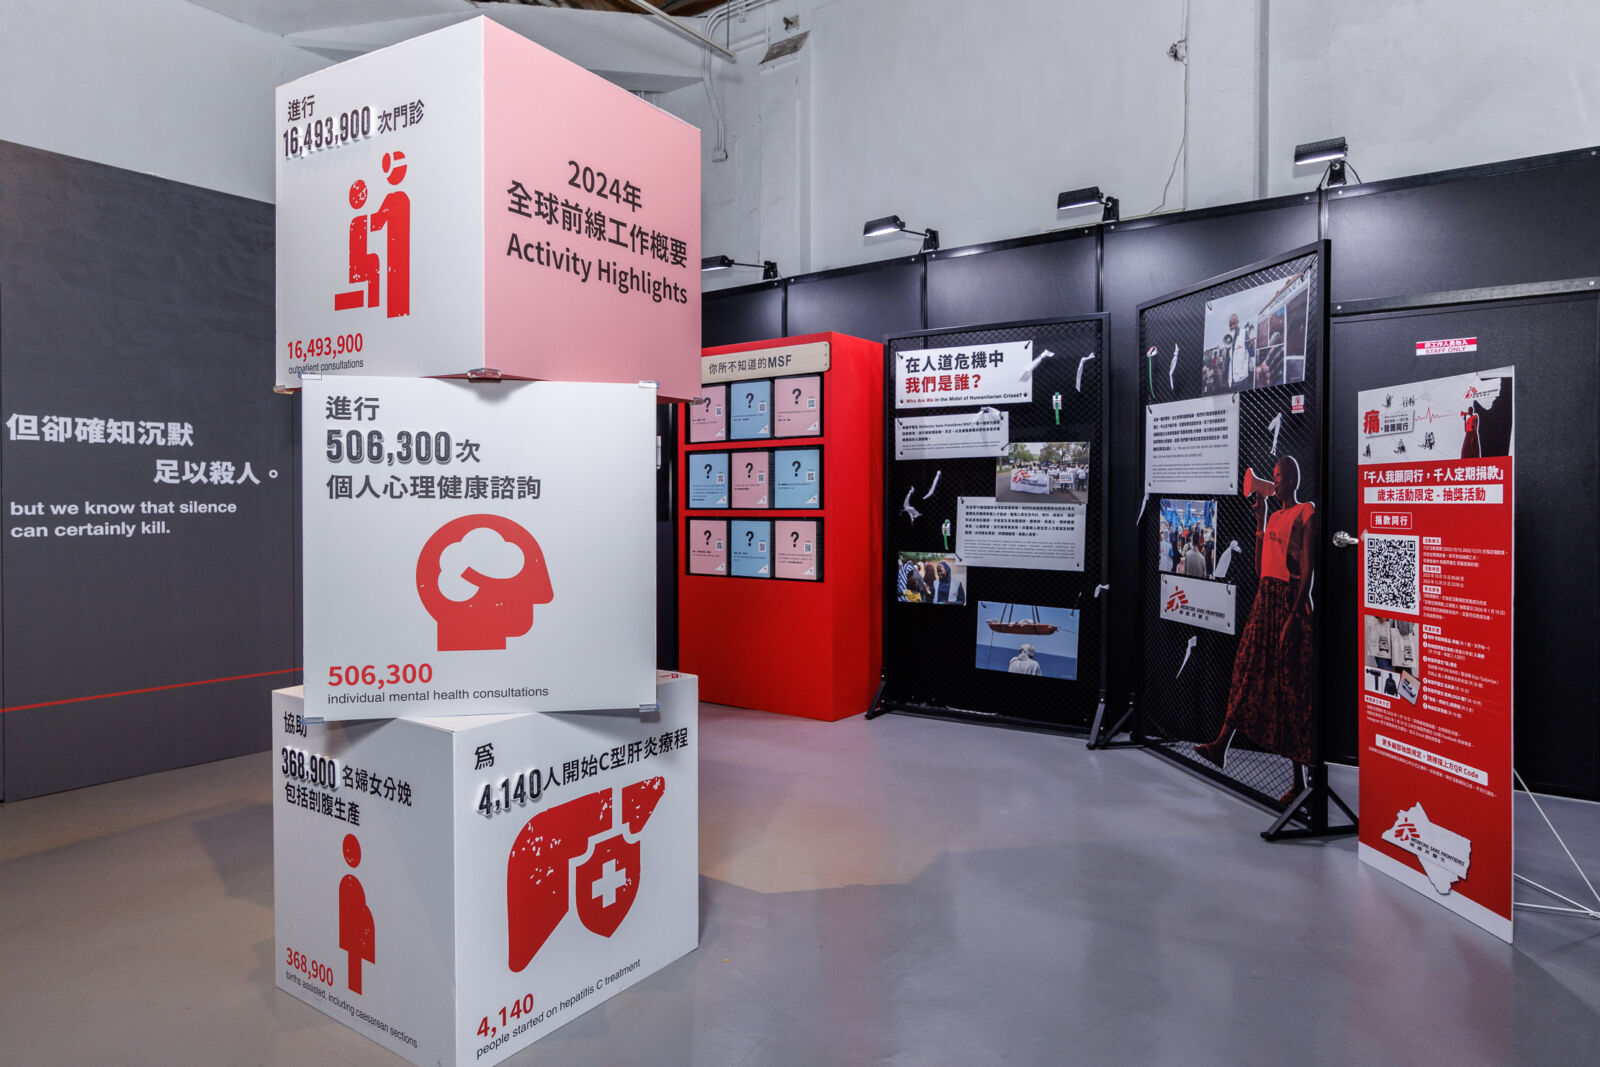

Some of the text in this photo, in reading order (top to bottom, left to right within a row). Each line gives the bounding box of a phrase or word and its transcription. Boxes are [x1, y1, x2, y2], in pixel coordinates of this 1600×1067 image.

[287, 94, 316, 123] 進行
[283, 99, 425, 157] 16,493,900 次門診
[568, 160, 643, 212] 2024年
[506, 232, 688, 304] Activity Highlights
[288, 333, 363, 362] 16,493,900
[288, 359, 364, 375] outpatient consultations
[709, 354, 792, 375] 你所不知道的MSF
[905, 349, 1004, 374] 在人道危機中
[326, 396, 380, 421] 進行
[704, 397, 712, 413] ?
[746, 392, 754, 408] ?
[792, 388, 802, 404] ?
[6, 413, 194, 447] 但卻確知沉默
[153, 459, 279, 485] 足以殺人。
[704, 463, 712, 479] ?
[745, 462, 754, 478] ?
[792, 460, 801, 477] ?
[326, 474, 542, 500] 個人心理健康諮詢
[10, 501, 237, 516] but we know that silence
[10, 521, 170, 538] can certainly kill.
[704, 529, 712, 545] ?
[746, 531, 754, 547] ?
[791, 531, 799, 548] ?
[328, 663, 433, 689] 506,300
[328, 686, 549, 704] individual mental health consultations
[282, 747, 412, 807] 368,900 名婦女分娩
[285, 782, 360, 826] 包括剖腹生產
[286, 947, 334, 987] 368,900
[328, 992, 355, 1016] including
[355, 1008, 389, 1032] caesarean
[390, 1026, 418, 1049] sections
[476, 959, 641, 1060] people started on hepatitis C treatment
[477, 993, 534, 1038] 4,140
